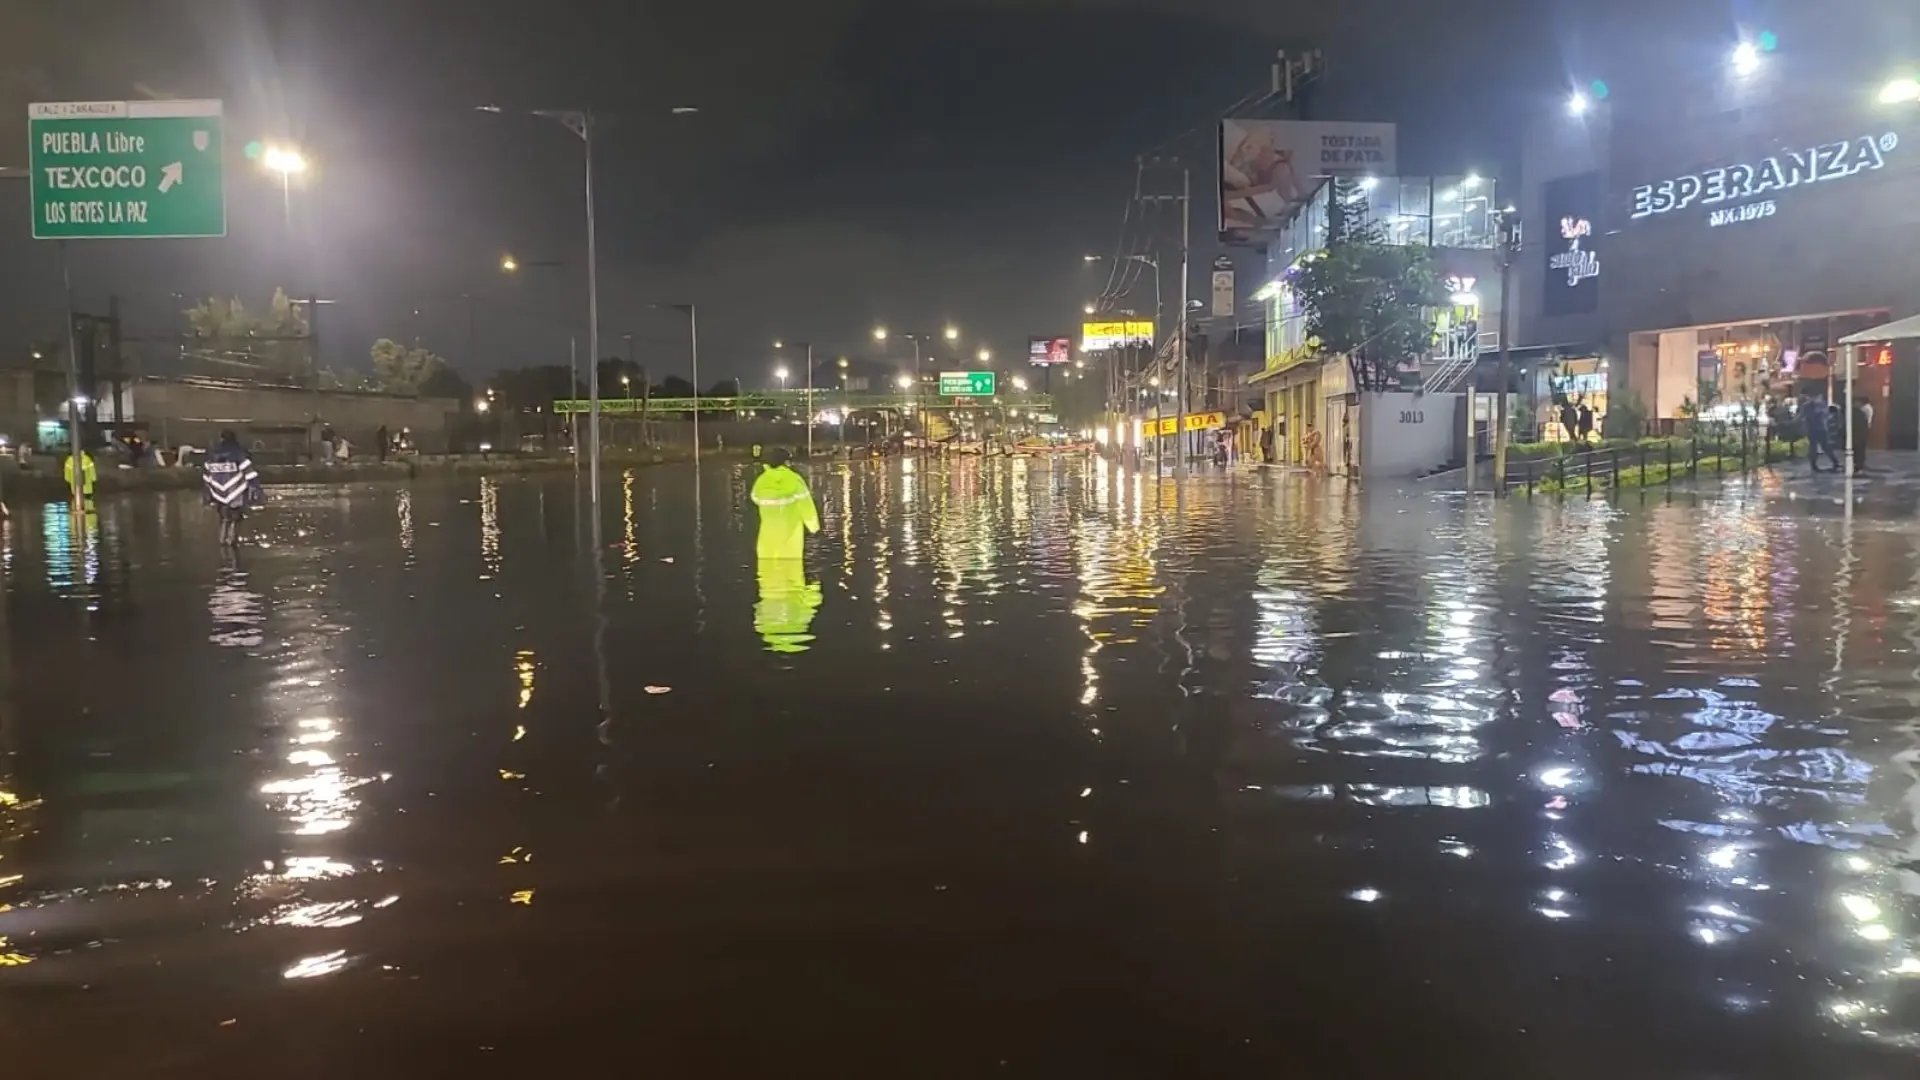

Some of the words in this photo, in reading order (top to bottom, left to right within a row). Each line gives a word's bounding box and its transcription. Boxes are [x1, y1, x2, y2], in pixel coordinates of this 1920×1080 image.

[42, 132, 101, 154] PUEBLA
[107, 131, 145, 153] Libre
[1320, 135, 1382, 147] TOSTADA
[1320, 149, 1341, 162] DE
[1345, 149, 1385, 163] PATA
[44, 166, 146, 188] TEXCOCO
[45, 202, 66, 224] LOS
[70, 202, 104, 223] REYES
[109, 202, 124, 223] LA
[127, 201, 148, 223] PAZ
[1399, 410, 1424, 424] 3013
